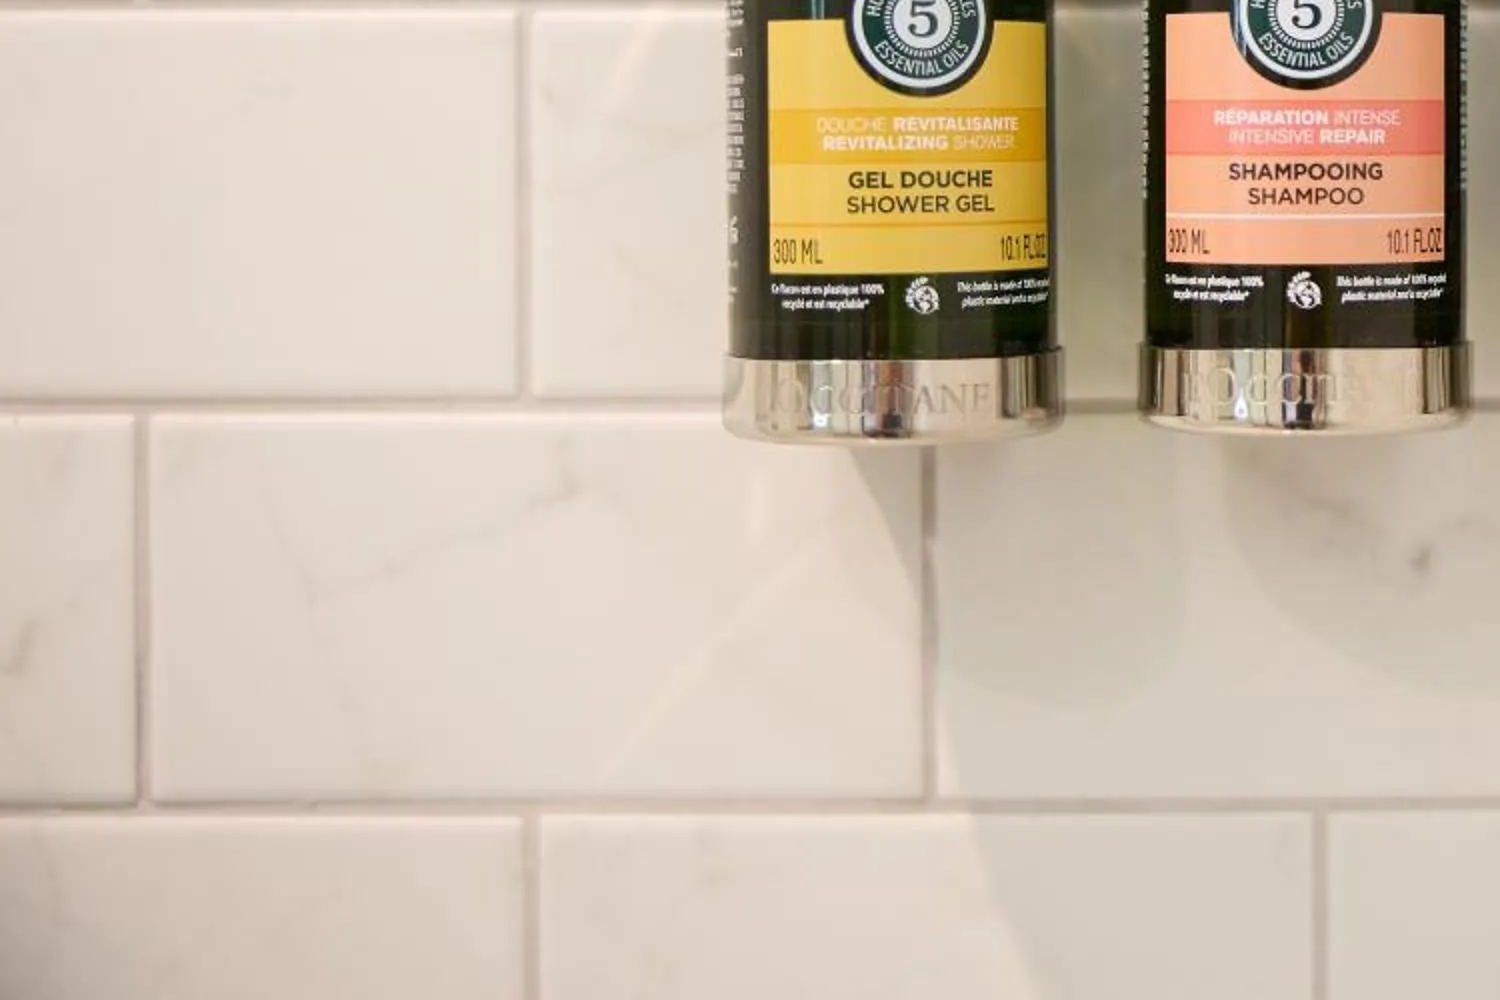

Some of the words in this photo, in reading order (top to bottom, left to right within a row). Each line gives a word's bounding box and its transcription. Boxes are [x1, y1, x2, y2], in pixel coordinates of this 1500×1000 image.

[908, 0, 939, 37] 5
[874, 39, 943, 77] ESSENTIAL
[942, 39, 969, 69] OILS
[1258, 31, 1327, 68] ESSENTIAL
[1327, 33, 1355, 62] OILS
[817, 117, 886, 133] DOUCHE
[893, 116, 1019, 132] REVITALISANTE
[1214, 108, 1328, 125] RÉPARATION
[1333, 108, 1401, 125] INTENSE
[822, 135, 948, 150] REVITALIZING
[954, 134, 1015, 149] SHOWER
[1229, 129, 1314, 145] INTENSIVE
[1320, 129, 1385, 145] REPAIR
[848, 171, 893, 189] GEL
[901, 169, 993, 188] DOUCHE
[1229, 162, 1384, 181] SHAMPOOING
[847, 196, 949, 214] SHOWER
[956, 194, 995, 213] GEL
[1248, 187, 1365, 205] SHAMPOO
[773, 239, 797, 264] 300
[801, 239, 823, 264] ML
[1191, 229, 1210, 254] ML
